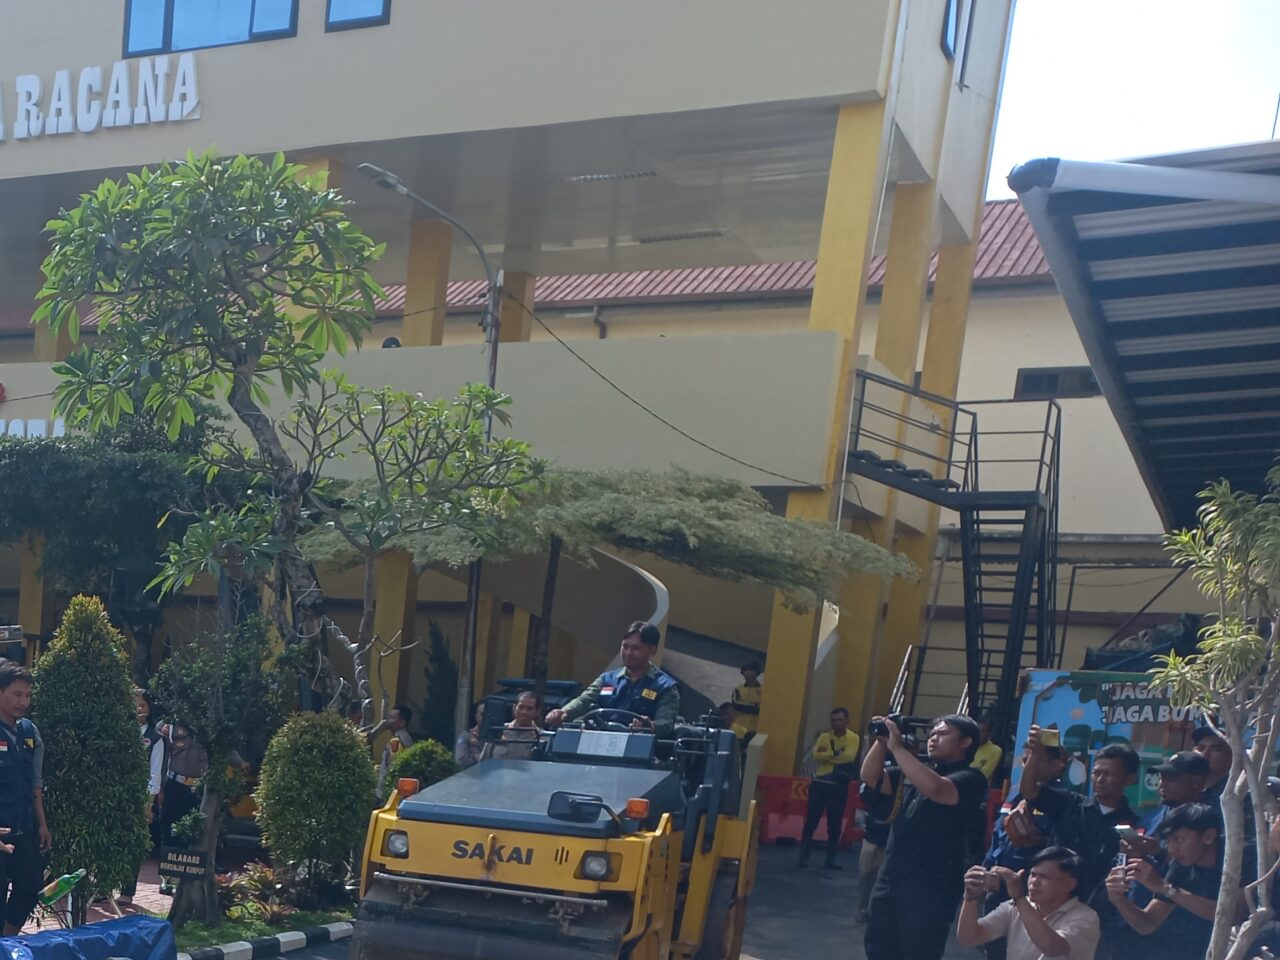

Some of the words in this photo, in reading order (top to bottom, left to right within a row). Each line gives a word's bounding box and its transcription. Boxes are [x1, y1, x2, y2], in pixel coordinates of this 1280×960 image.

[13, 52, 201, 139] RACANA
[1101, 704, 1155, 724] JAGA
[1157, 704, 1205, 723] BUM
[450, 839, 535, 866] SAKAI
